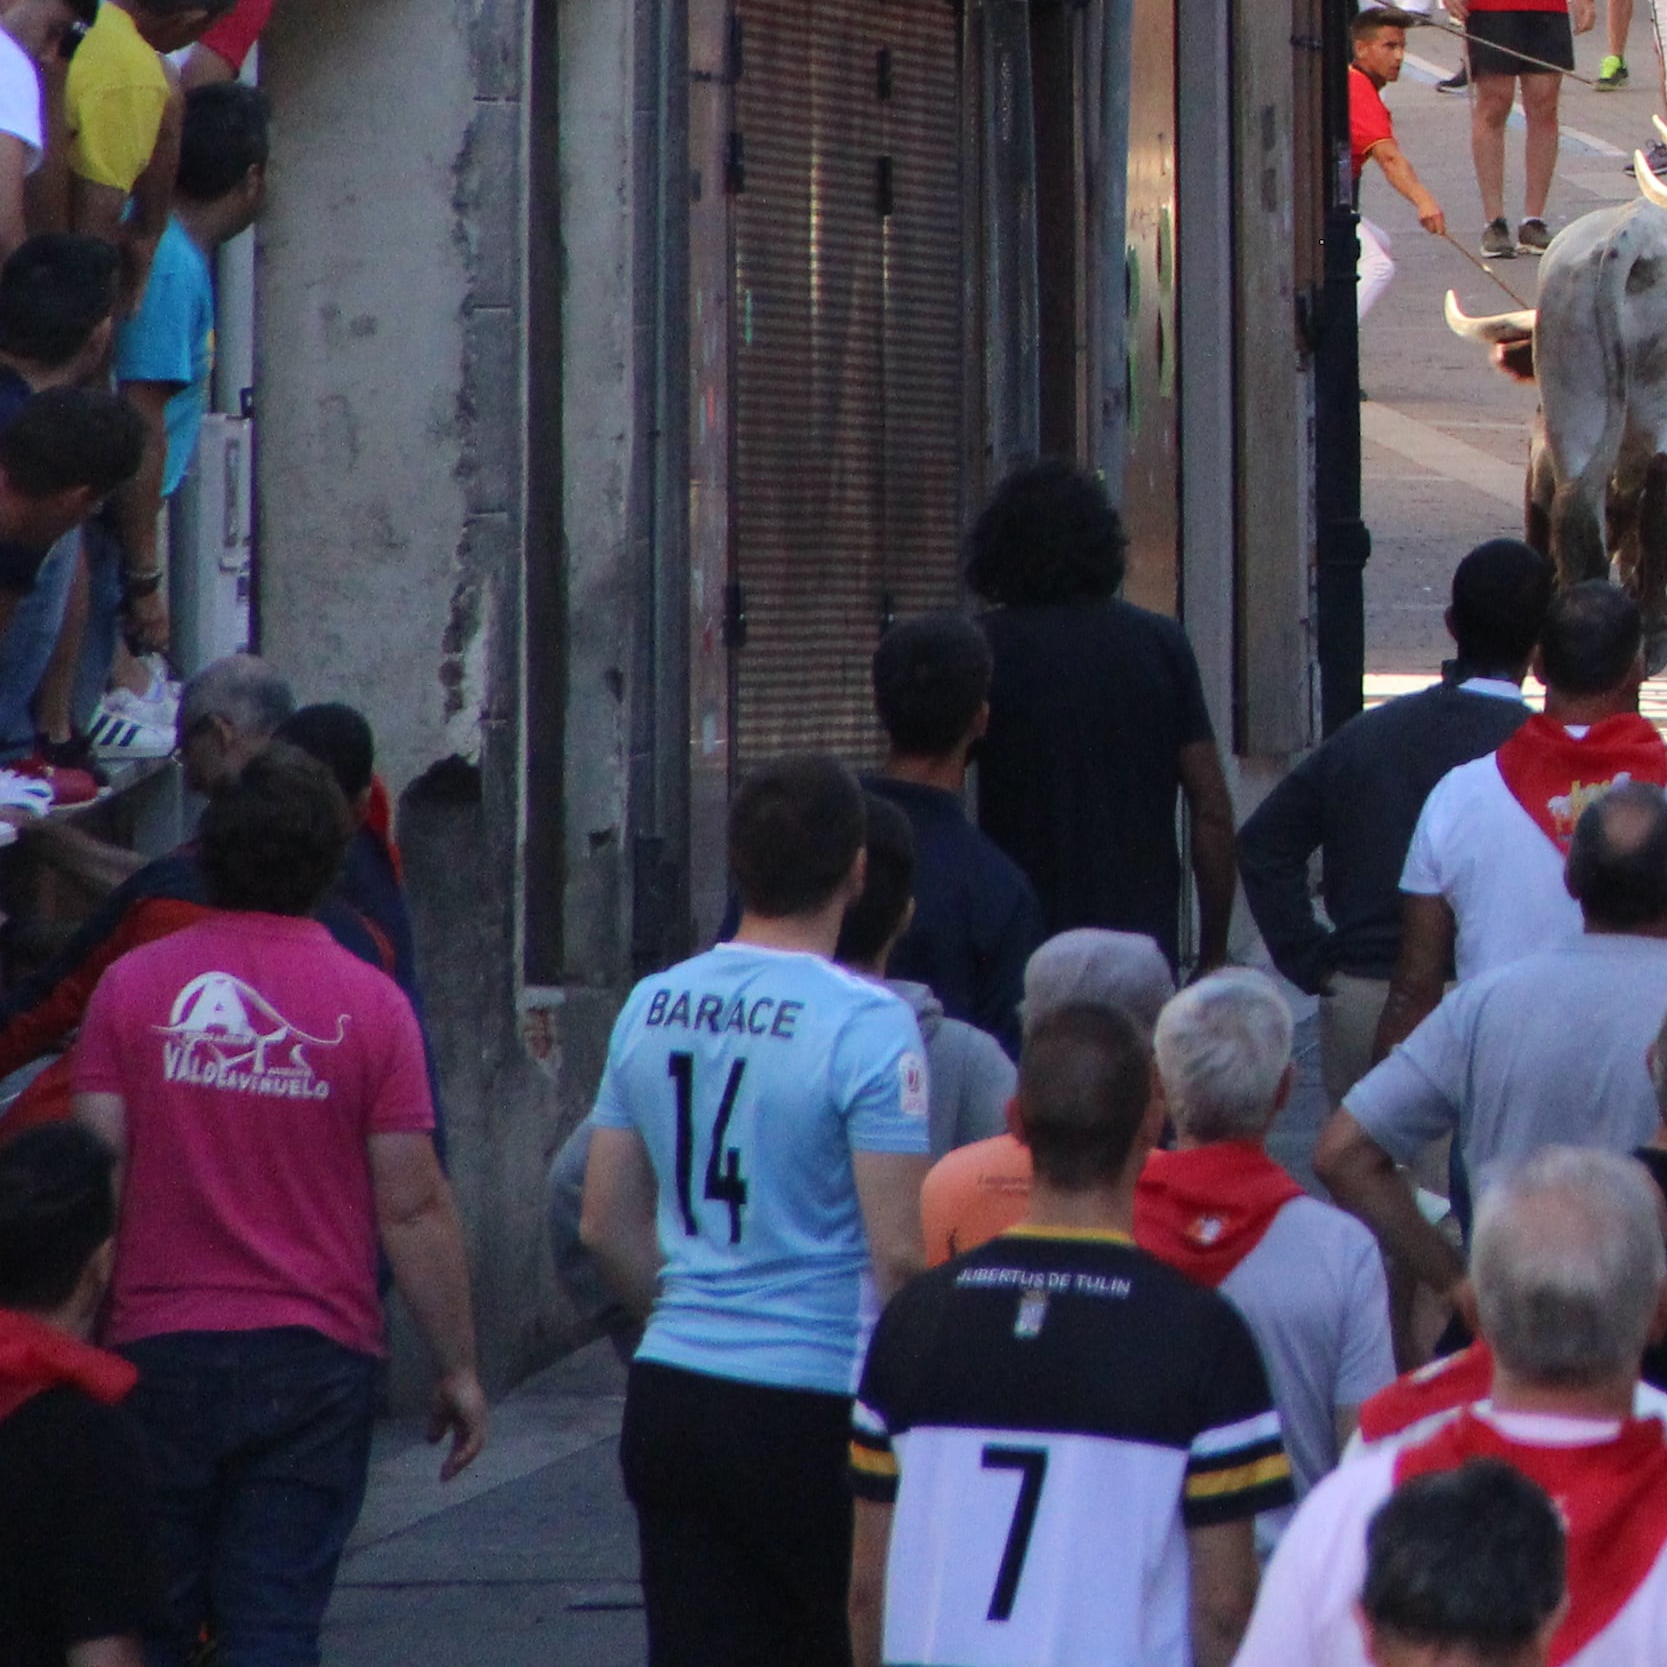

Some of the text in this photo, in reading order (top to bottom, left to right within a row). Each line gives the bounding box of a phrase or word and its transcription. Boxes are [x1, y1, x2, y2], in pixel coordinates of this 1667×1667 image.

[646, 987, 805, 1039] BARACE
[668, 1049, 749, 1245] 14
[1048, 1271, 1071, 1289] DE
[981, 1443, 1049, 1622] 7
